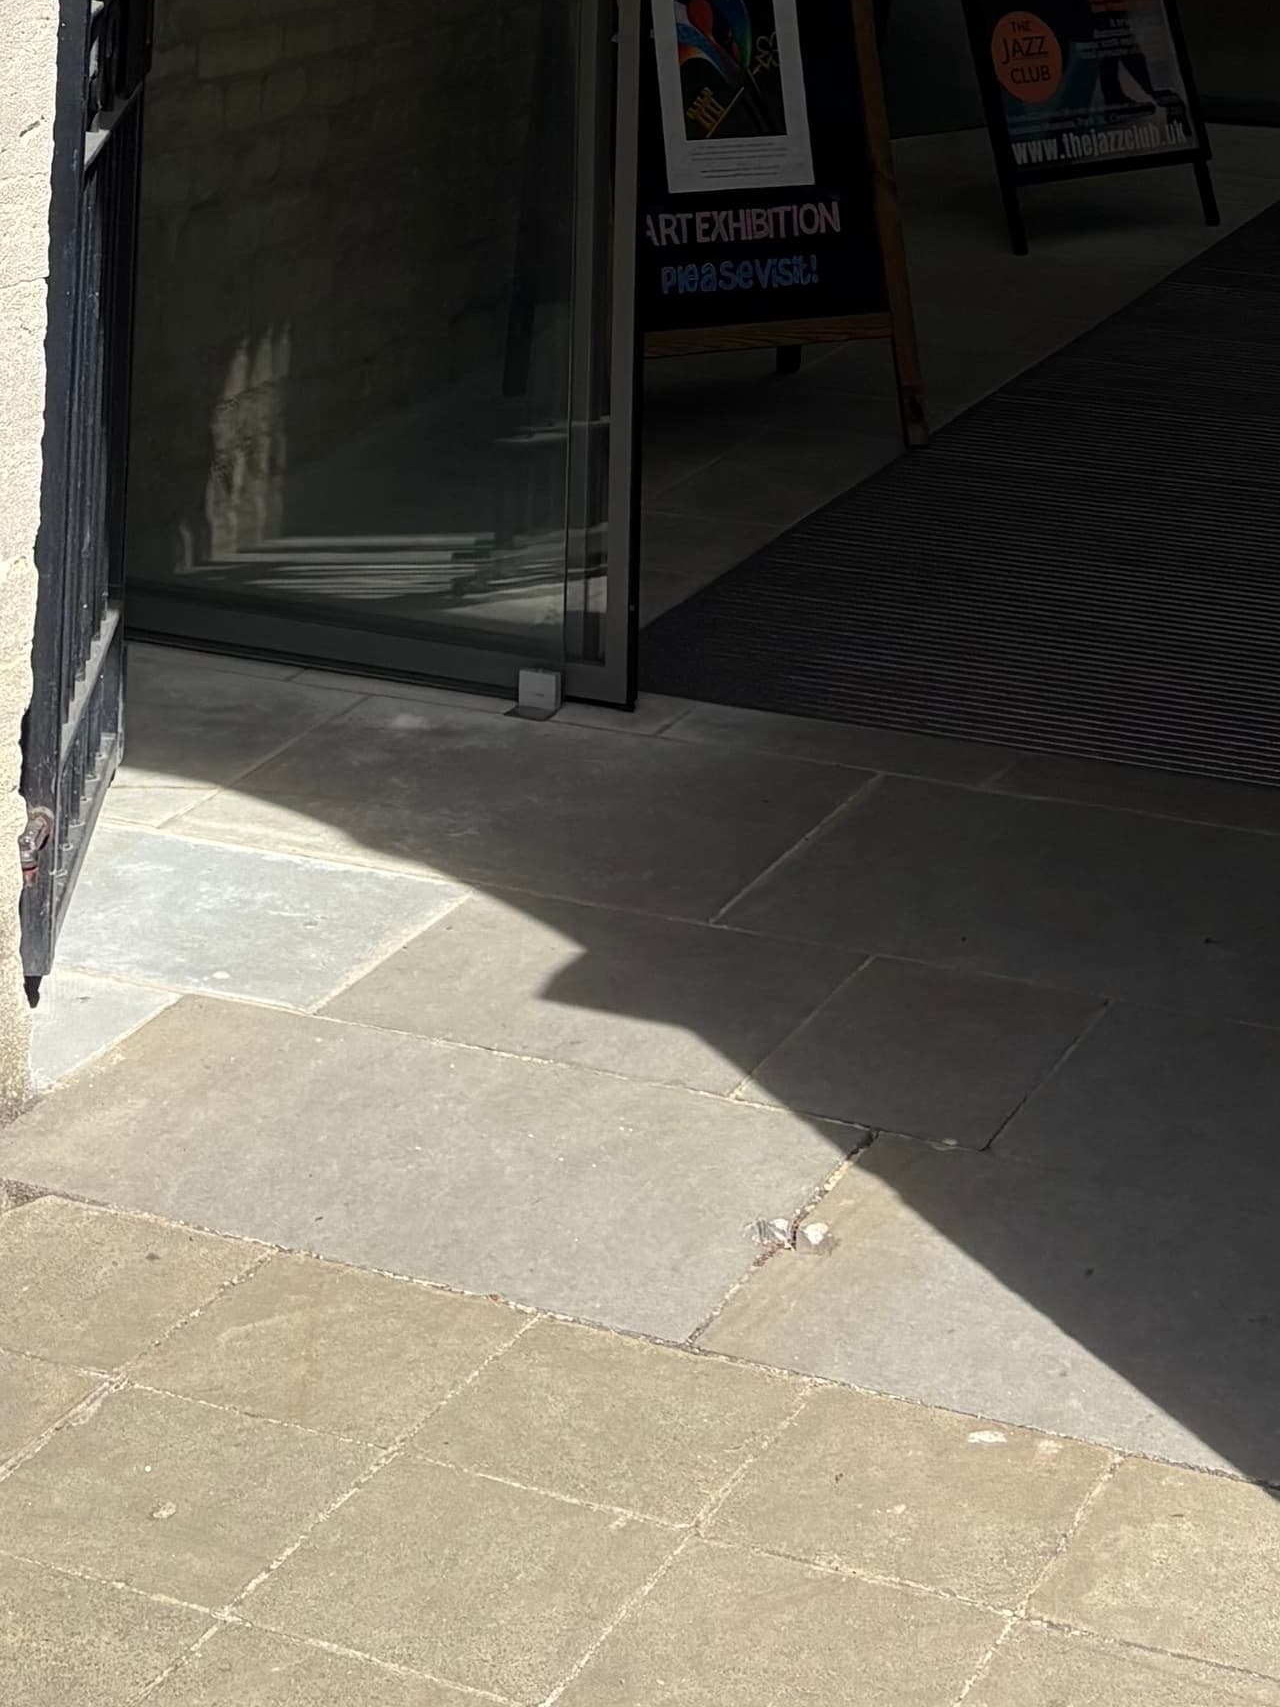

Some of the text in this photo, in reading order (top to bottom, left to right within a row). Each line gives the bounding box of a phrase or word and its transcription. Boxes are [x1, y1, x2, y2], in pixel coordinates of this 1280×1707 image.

[1011, 19, 1032, 33] THE
[1002, 36, 1048, 64] JAZZ
[1010, 65, 1051, 84] CLUB
[1011, 120, 1187, 165] www.thejazzclub.uk
[645, 201, 841, 247] ART EXHIBITION
